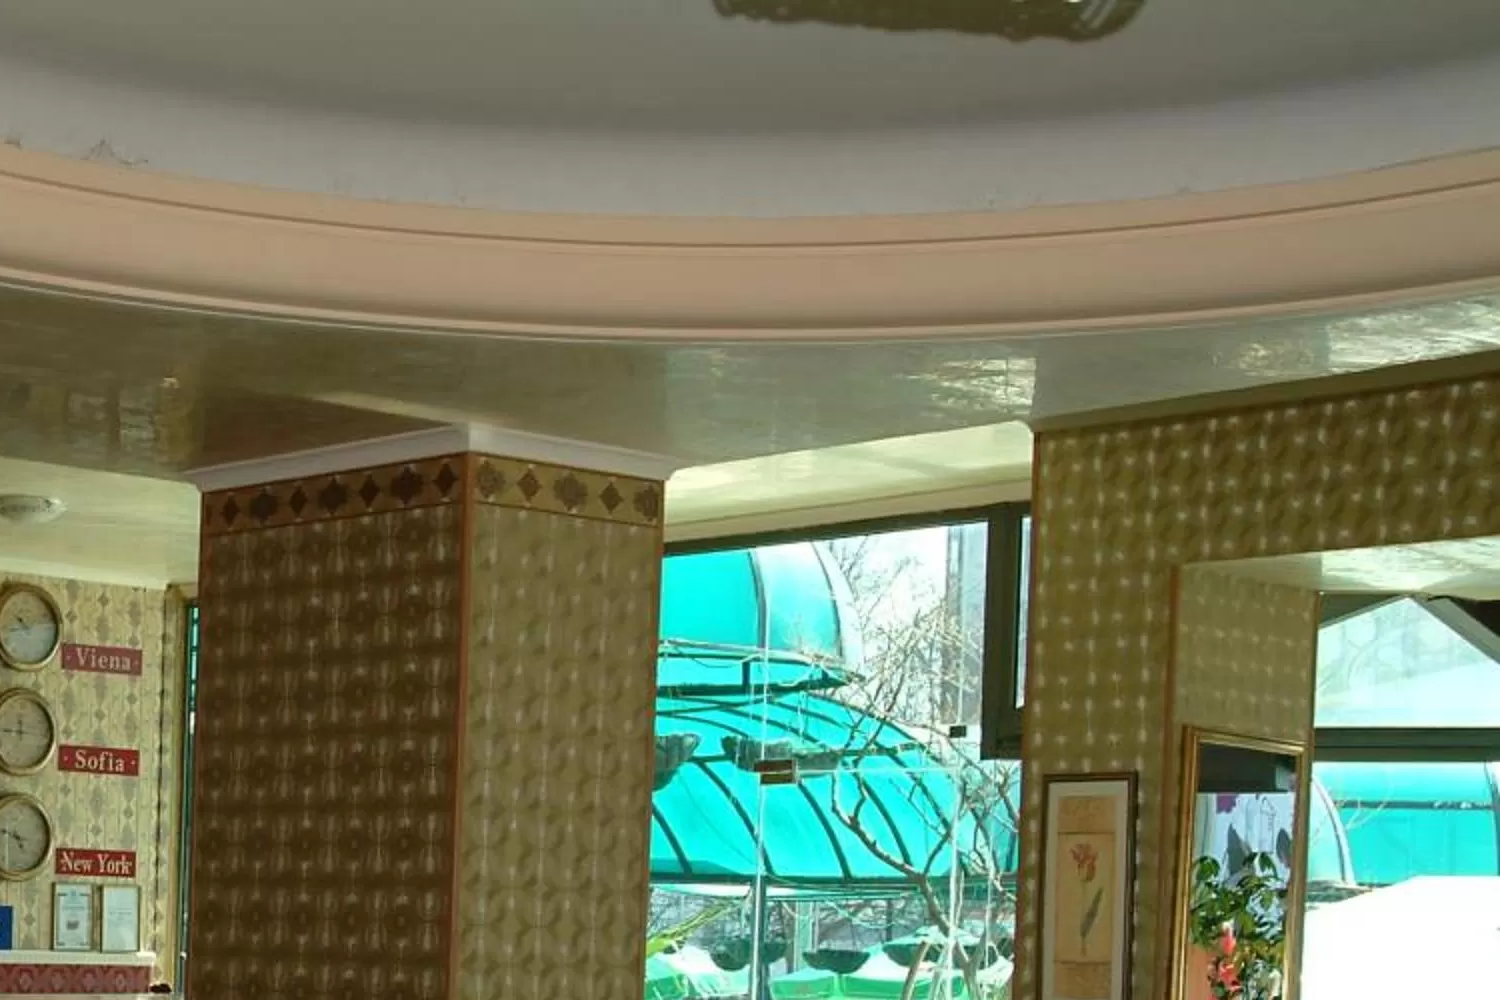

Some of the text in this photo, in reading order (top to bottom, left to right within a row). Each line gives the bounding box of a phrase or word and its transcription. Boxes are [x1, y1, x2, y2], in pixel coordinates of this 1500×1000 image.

[75, 647, 132, 670] Viena
[74, 749, 125, 773] Sofia
[61, 851, 130, 875] New York
